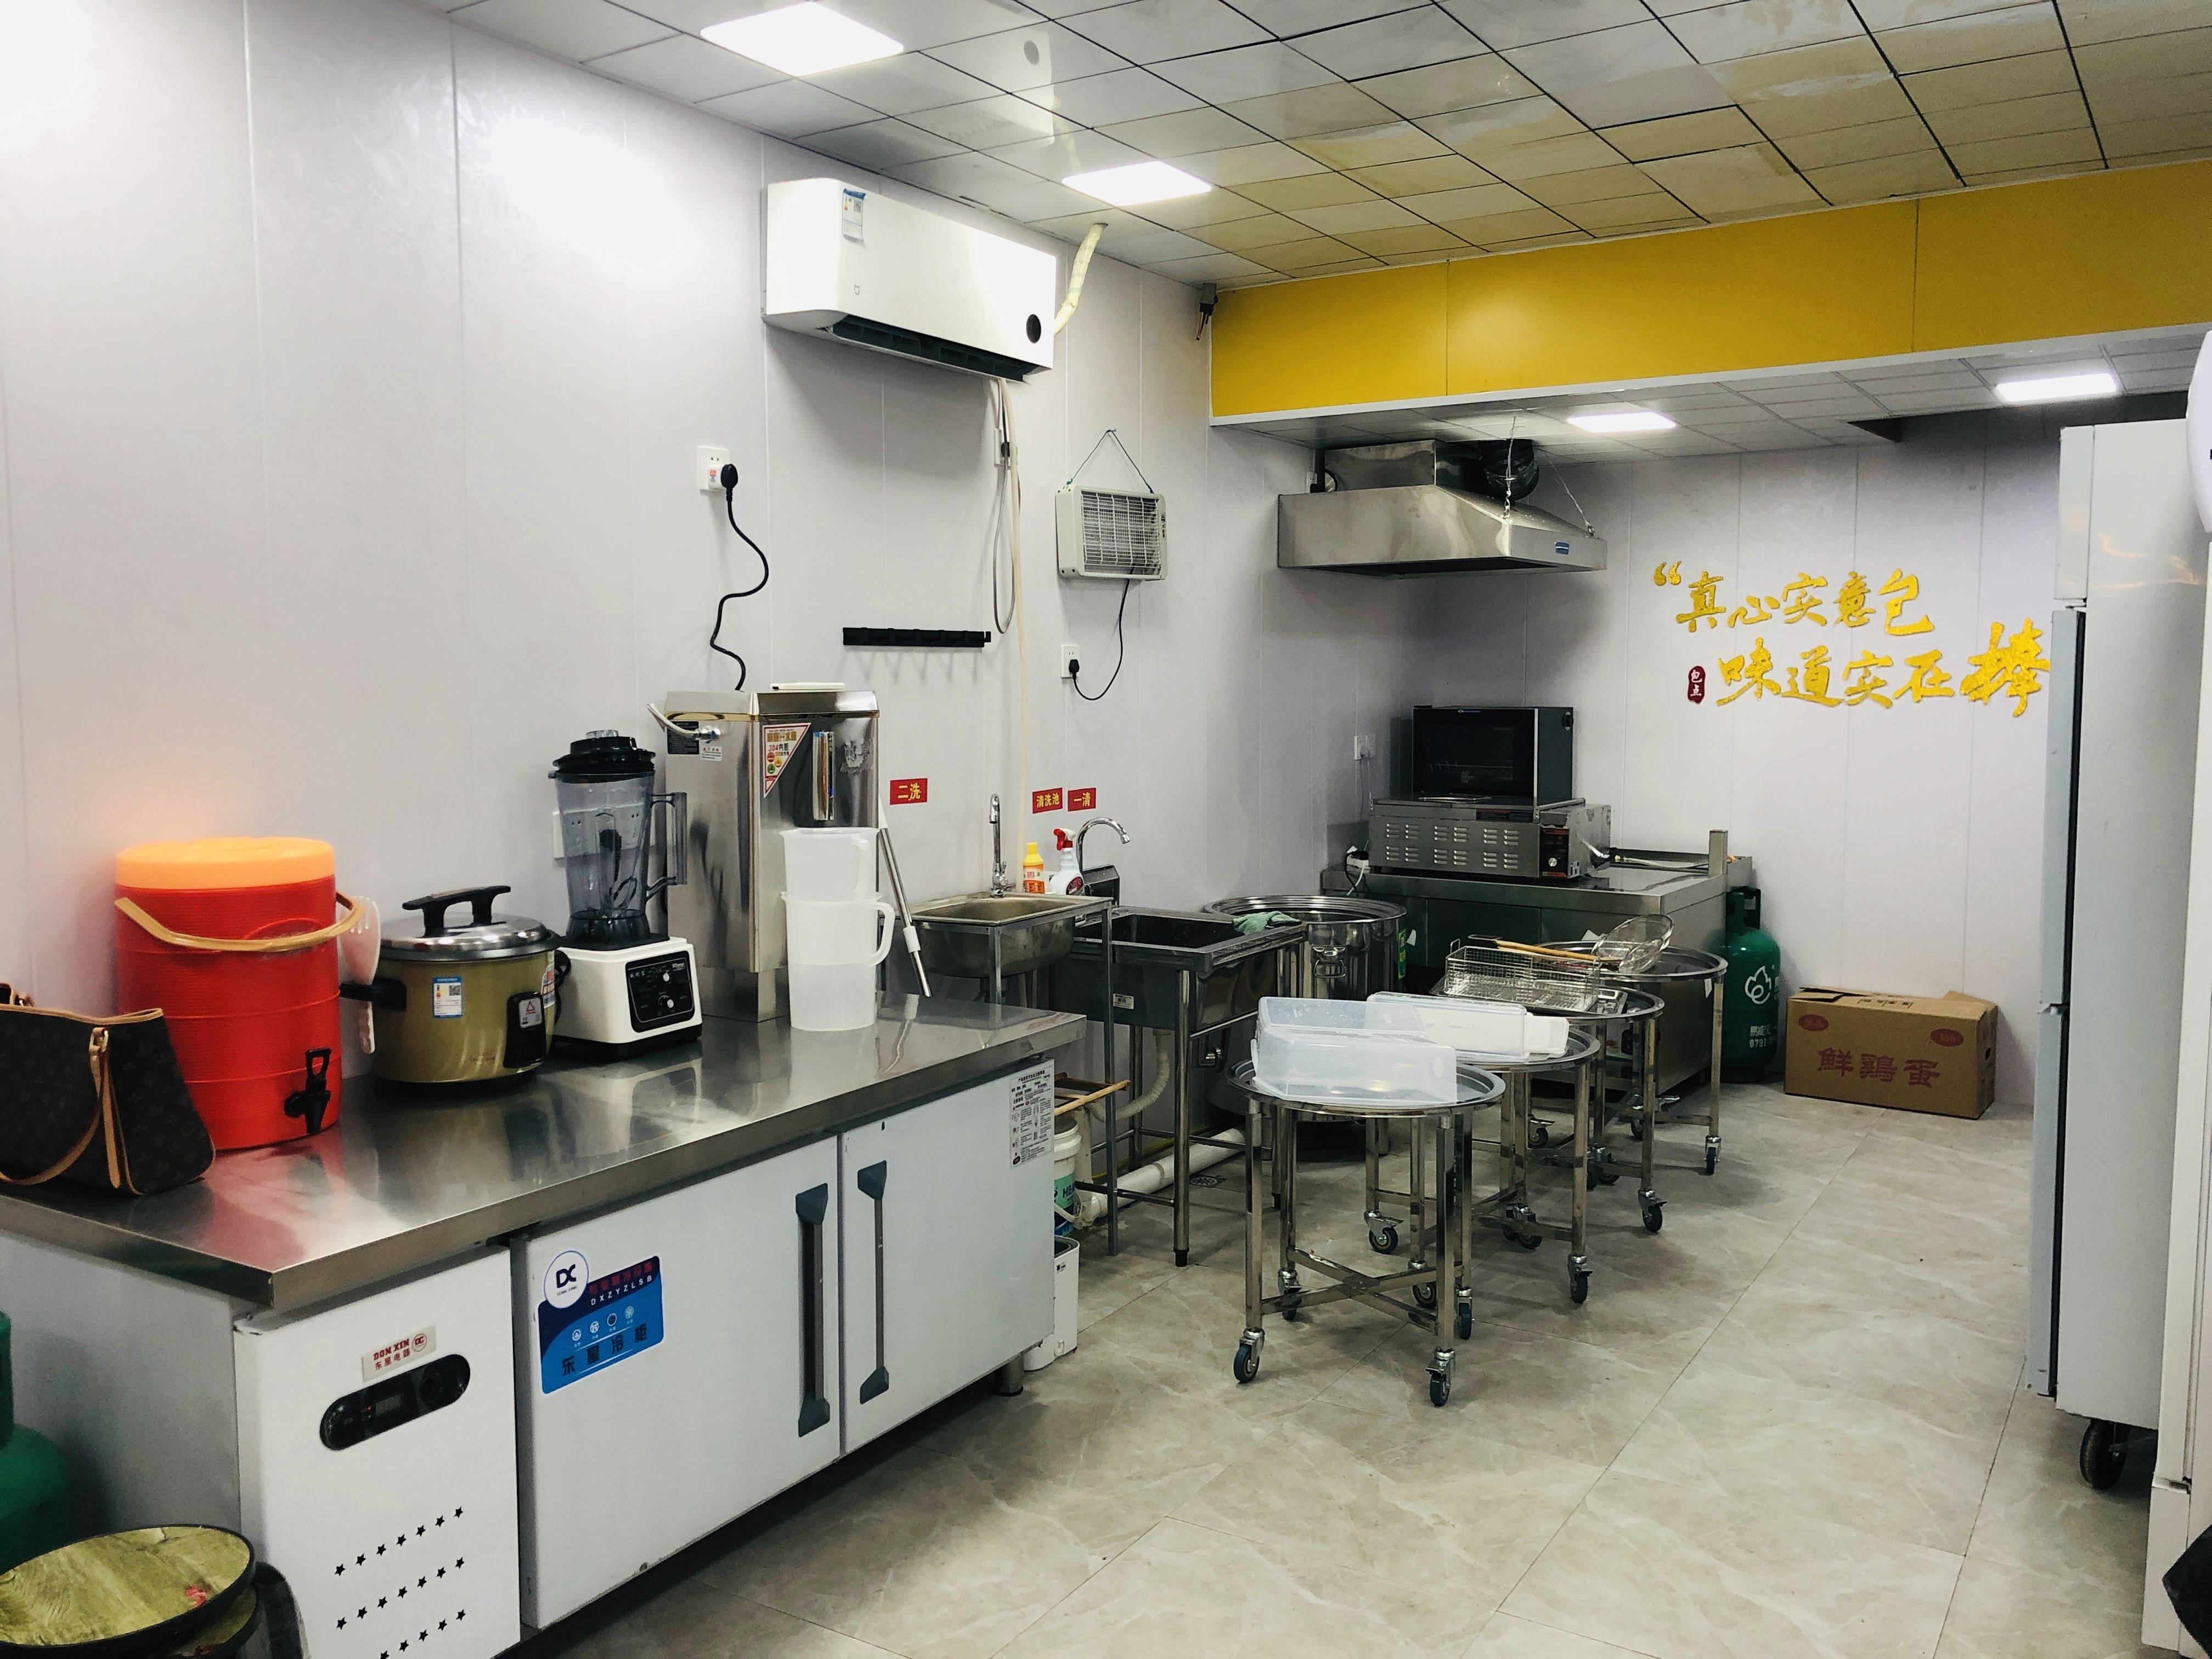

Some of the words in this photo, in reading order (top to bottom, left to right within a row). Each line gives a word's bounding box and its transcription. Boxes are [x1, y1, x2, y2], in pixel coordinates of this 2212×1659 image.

[898, 782, 922, 801] 二洗
[1074, 792, 1091, 807] 一清
[1036, 792, 1059, 808] 清洗池
